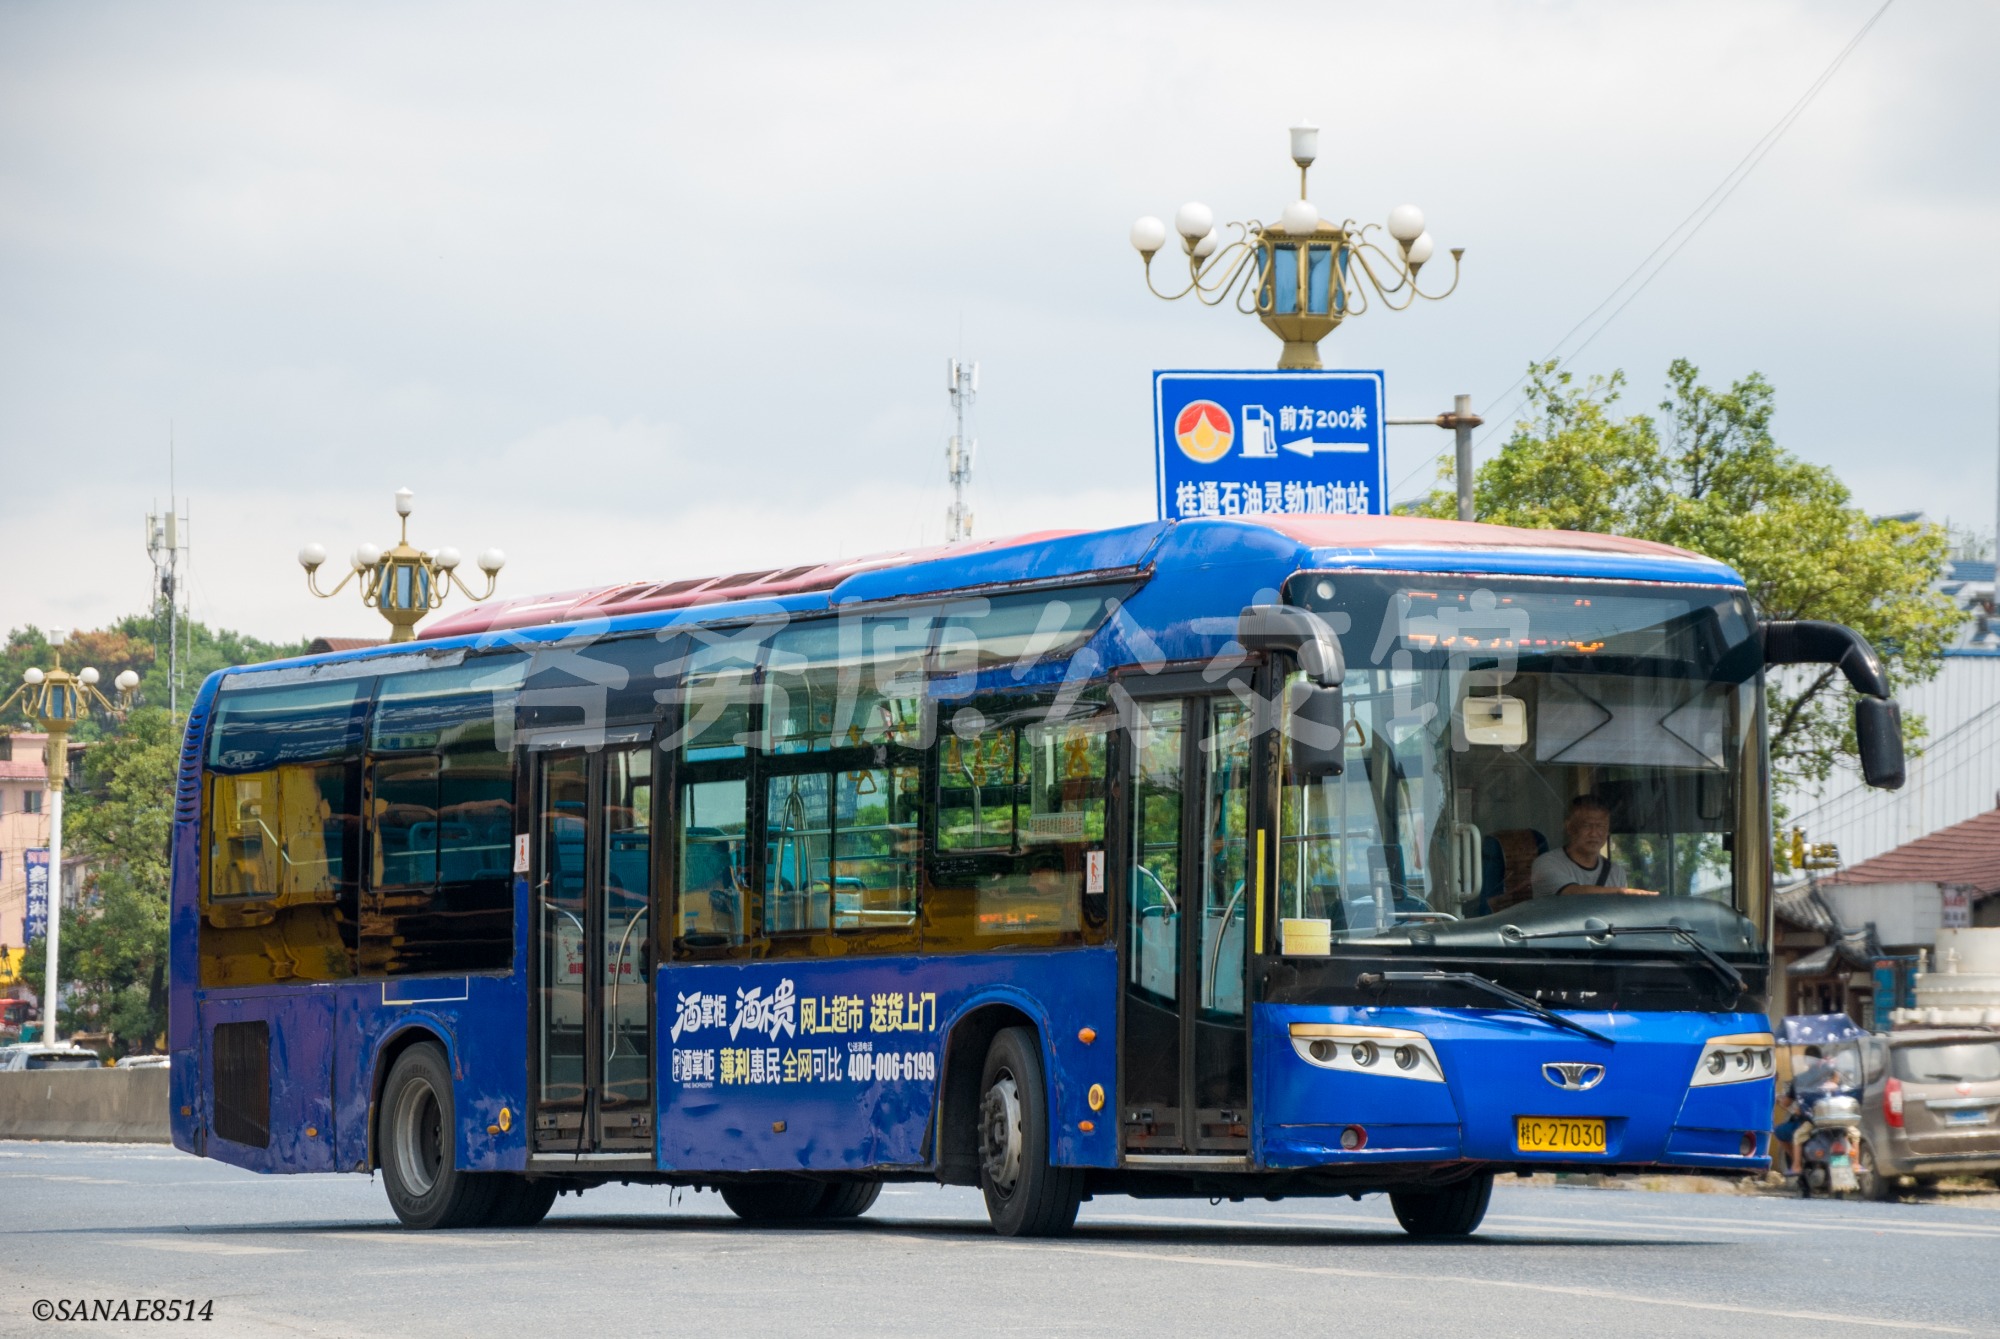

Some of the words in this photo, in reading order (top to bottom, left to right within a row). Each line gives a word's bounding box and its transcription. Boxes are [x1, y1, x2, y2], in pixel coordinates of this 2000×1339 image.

[1279, 405, 1367, 431] 前方200米
[1176, 480, 1369, 516] 桂通石油灵勃加油站
[670, 991, 727, 1043] 酒掌柜
[729, 978, 797, 1042] 酒不贵
[800, 995, 864, 1035] 网上超市
[870, 992, 936, 1033] 送货上门
[681, 1049, 715, 1081] 酒掌柜
[719, 1047, 781, 1085] 薄利惠民
[782, 1046, 842, 1082] 全网可比
[848, 1052, 935, 1081] 400-006-6199
